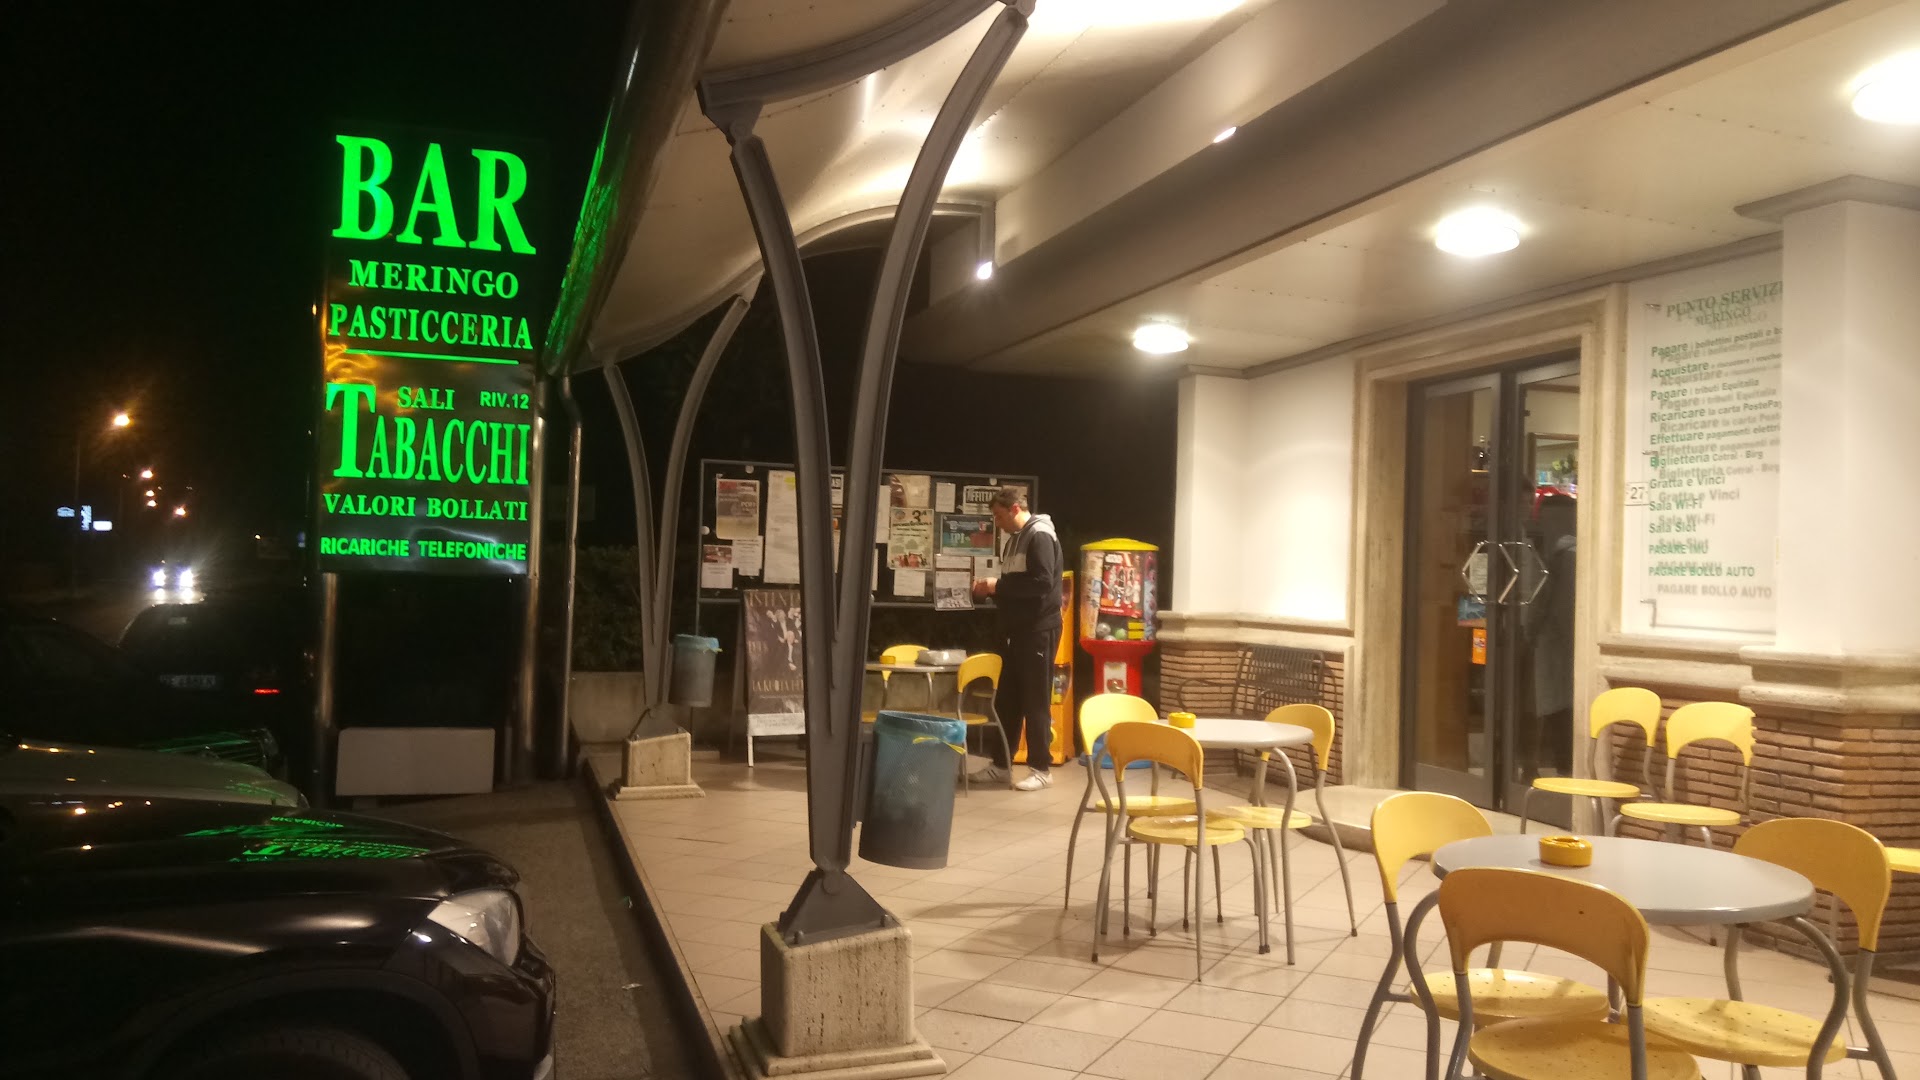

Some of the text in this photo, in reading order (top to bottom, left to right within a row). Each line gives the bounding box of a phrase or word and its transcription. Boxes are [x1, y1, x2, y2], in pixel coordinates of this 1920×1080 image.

[332, 135, 536, 255] BAR
[348, 259, 519, 299] MERINGO
[1666, 280, 1783, 317] PUNTO SERVIZI
[1695, 307, 1751, 325] MERINGO
[327, 303, 533, 350] PASTICCERIA
[1651, 343, 1688, 357] Pagare
[1651, 362, 1709, 378] Acquistare
[397, 386, 455, 410] SALI
[479, 390, 529, 409] RIV.12
[1650, 388, 1688, 401] Pagare
[1650, 408, 1705, 423] Ricaricare
[1718, 406, 1741, 415] carta
[325, 382, 530, 485] TABACCHI
[1650, 432, 1704, 445] Effettuare
[1649, 454, 1710, 468] Biglietteria
[1649, 475, 1726, 489] Gratta e Vinci
[1629, 486, 1645, 500] 27
[323, 493, 528, 521] VALORI BOLLATI
[1649, 499, 1703, 511] Sala Wi-Fi
[1648, 521, 1696, 534] Sala Slot
[320, 536, 527, 561] RICARICHE TELEFONICHE
[1648, 544, 1686, 554] PAGARE
[1648, 567, 1755, 577] PAGARE BOLLO AUTO
